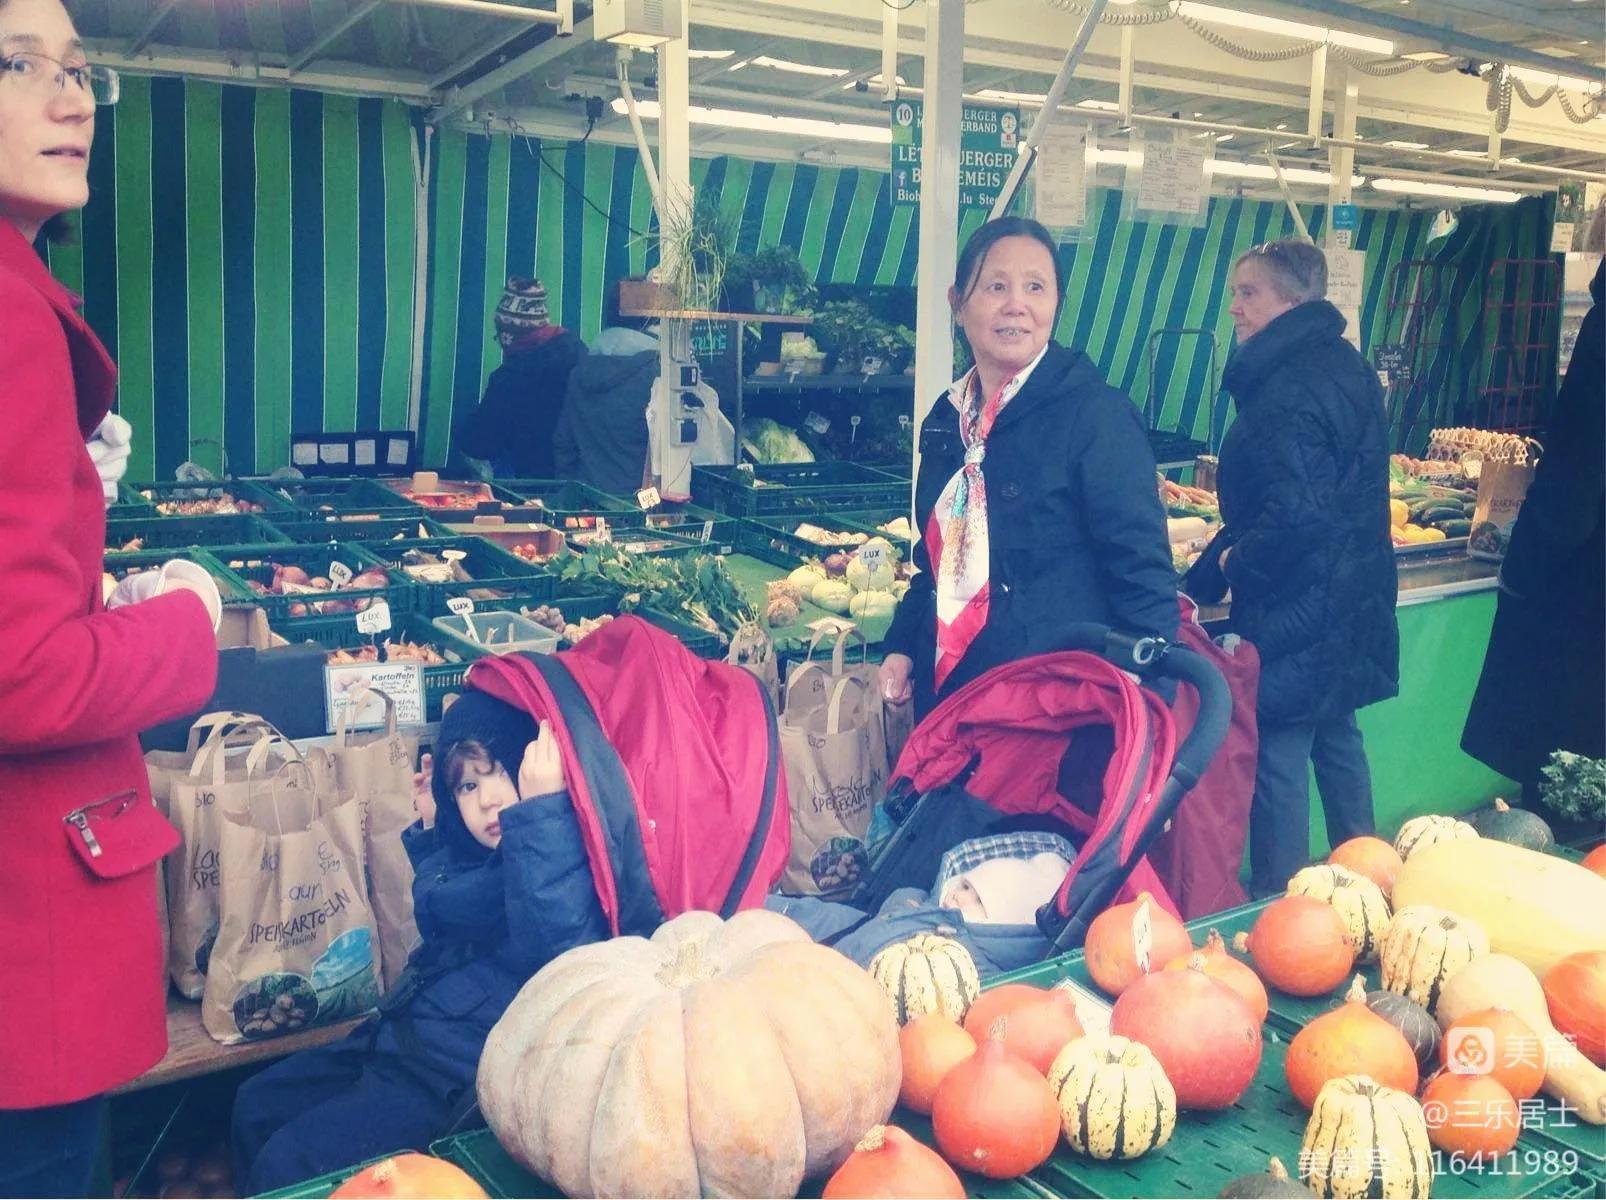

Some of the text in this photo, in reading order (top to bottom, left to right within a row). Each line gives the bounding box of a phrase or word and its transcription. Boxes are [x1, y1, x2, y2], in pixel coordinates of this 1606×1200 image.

[864, 550, 880, 558] LUX
[362, 611, 380, 623] LUX
[371, 672, 415, 681] Kartoffeln
